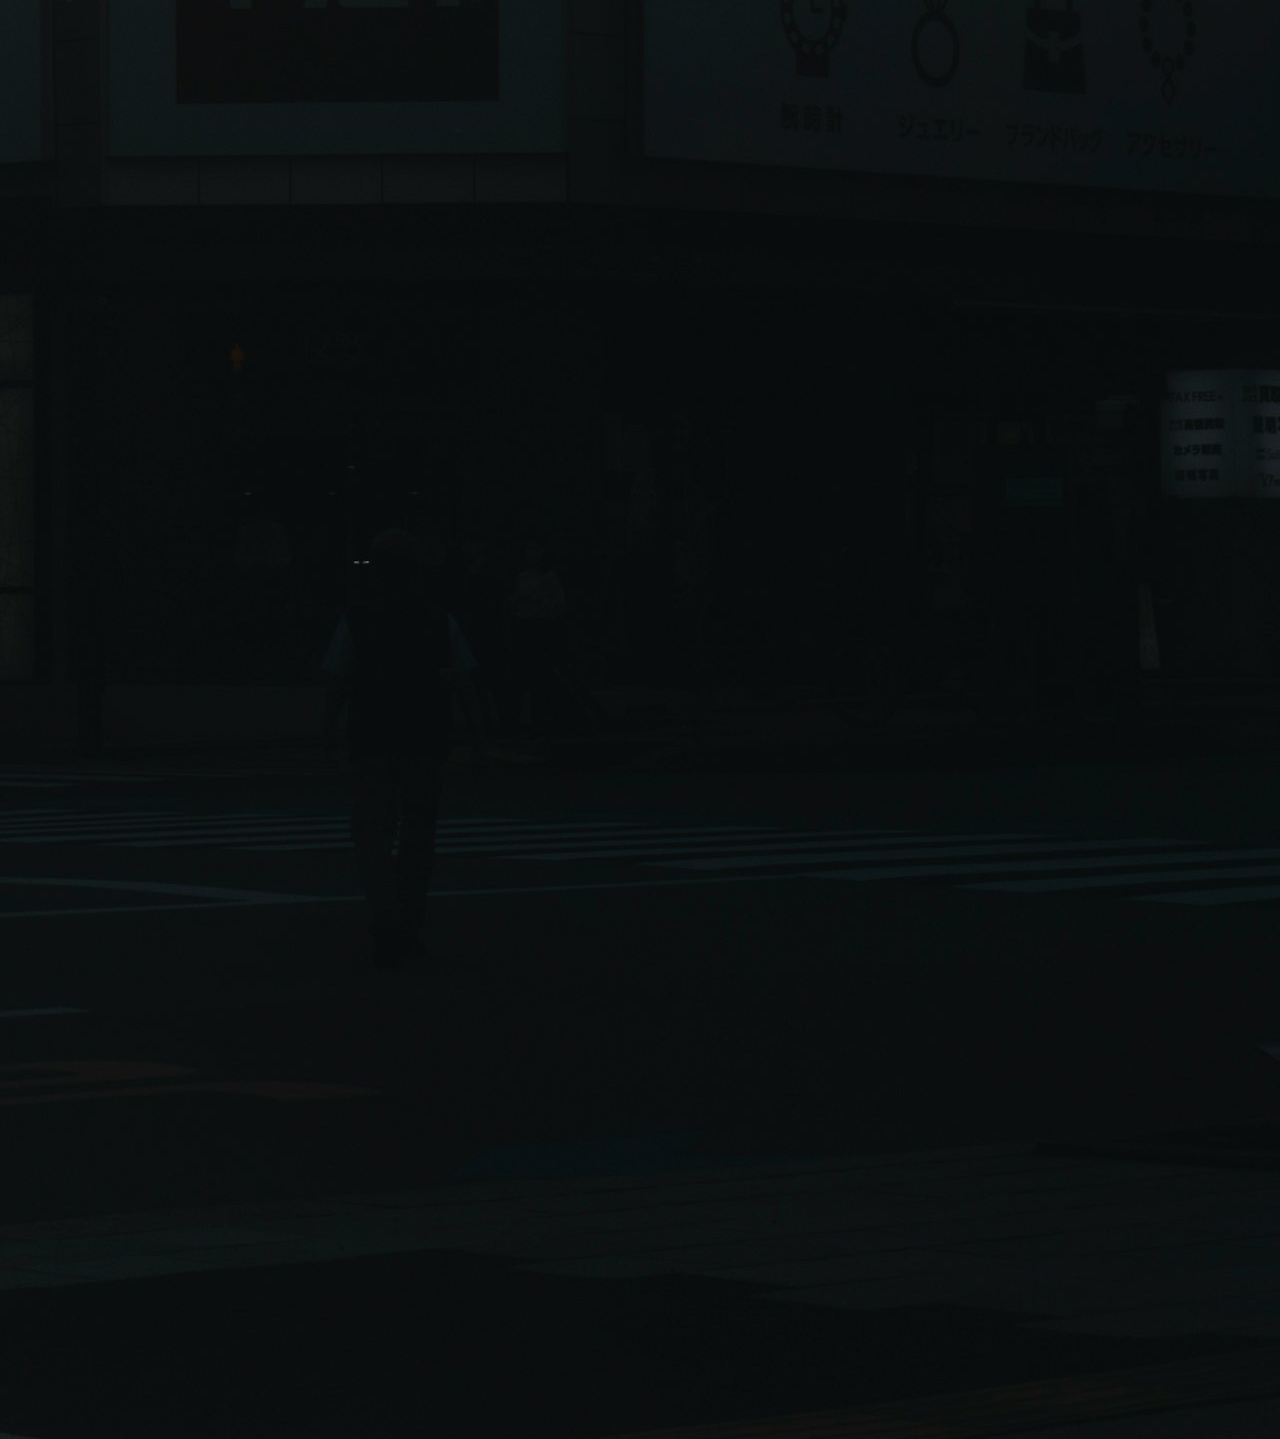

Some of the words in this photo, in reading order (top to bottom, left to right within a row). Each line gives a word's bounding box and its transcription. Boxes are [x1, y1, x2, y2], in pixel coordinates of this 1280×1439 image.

[898, 112, 981, 143] ジュエリー
[1126, 131, 1217, 160] アクセサリー
